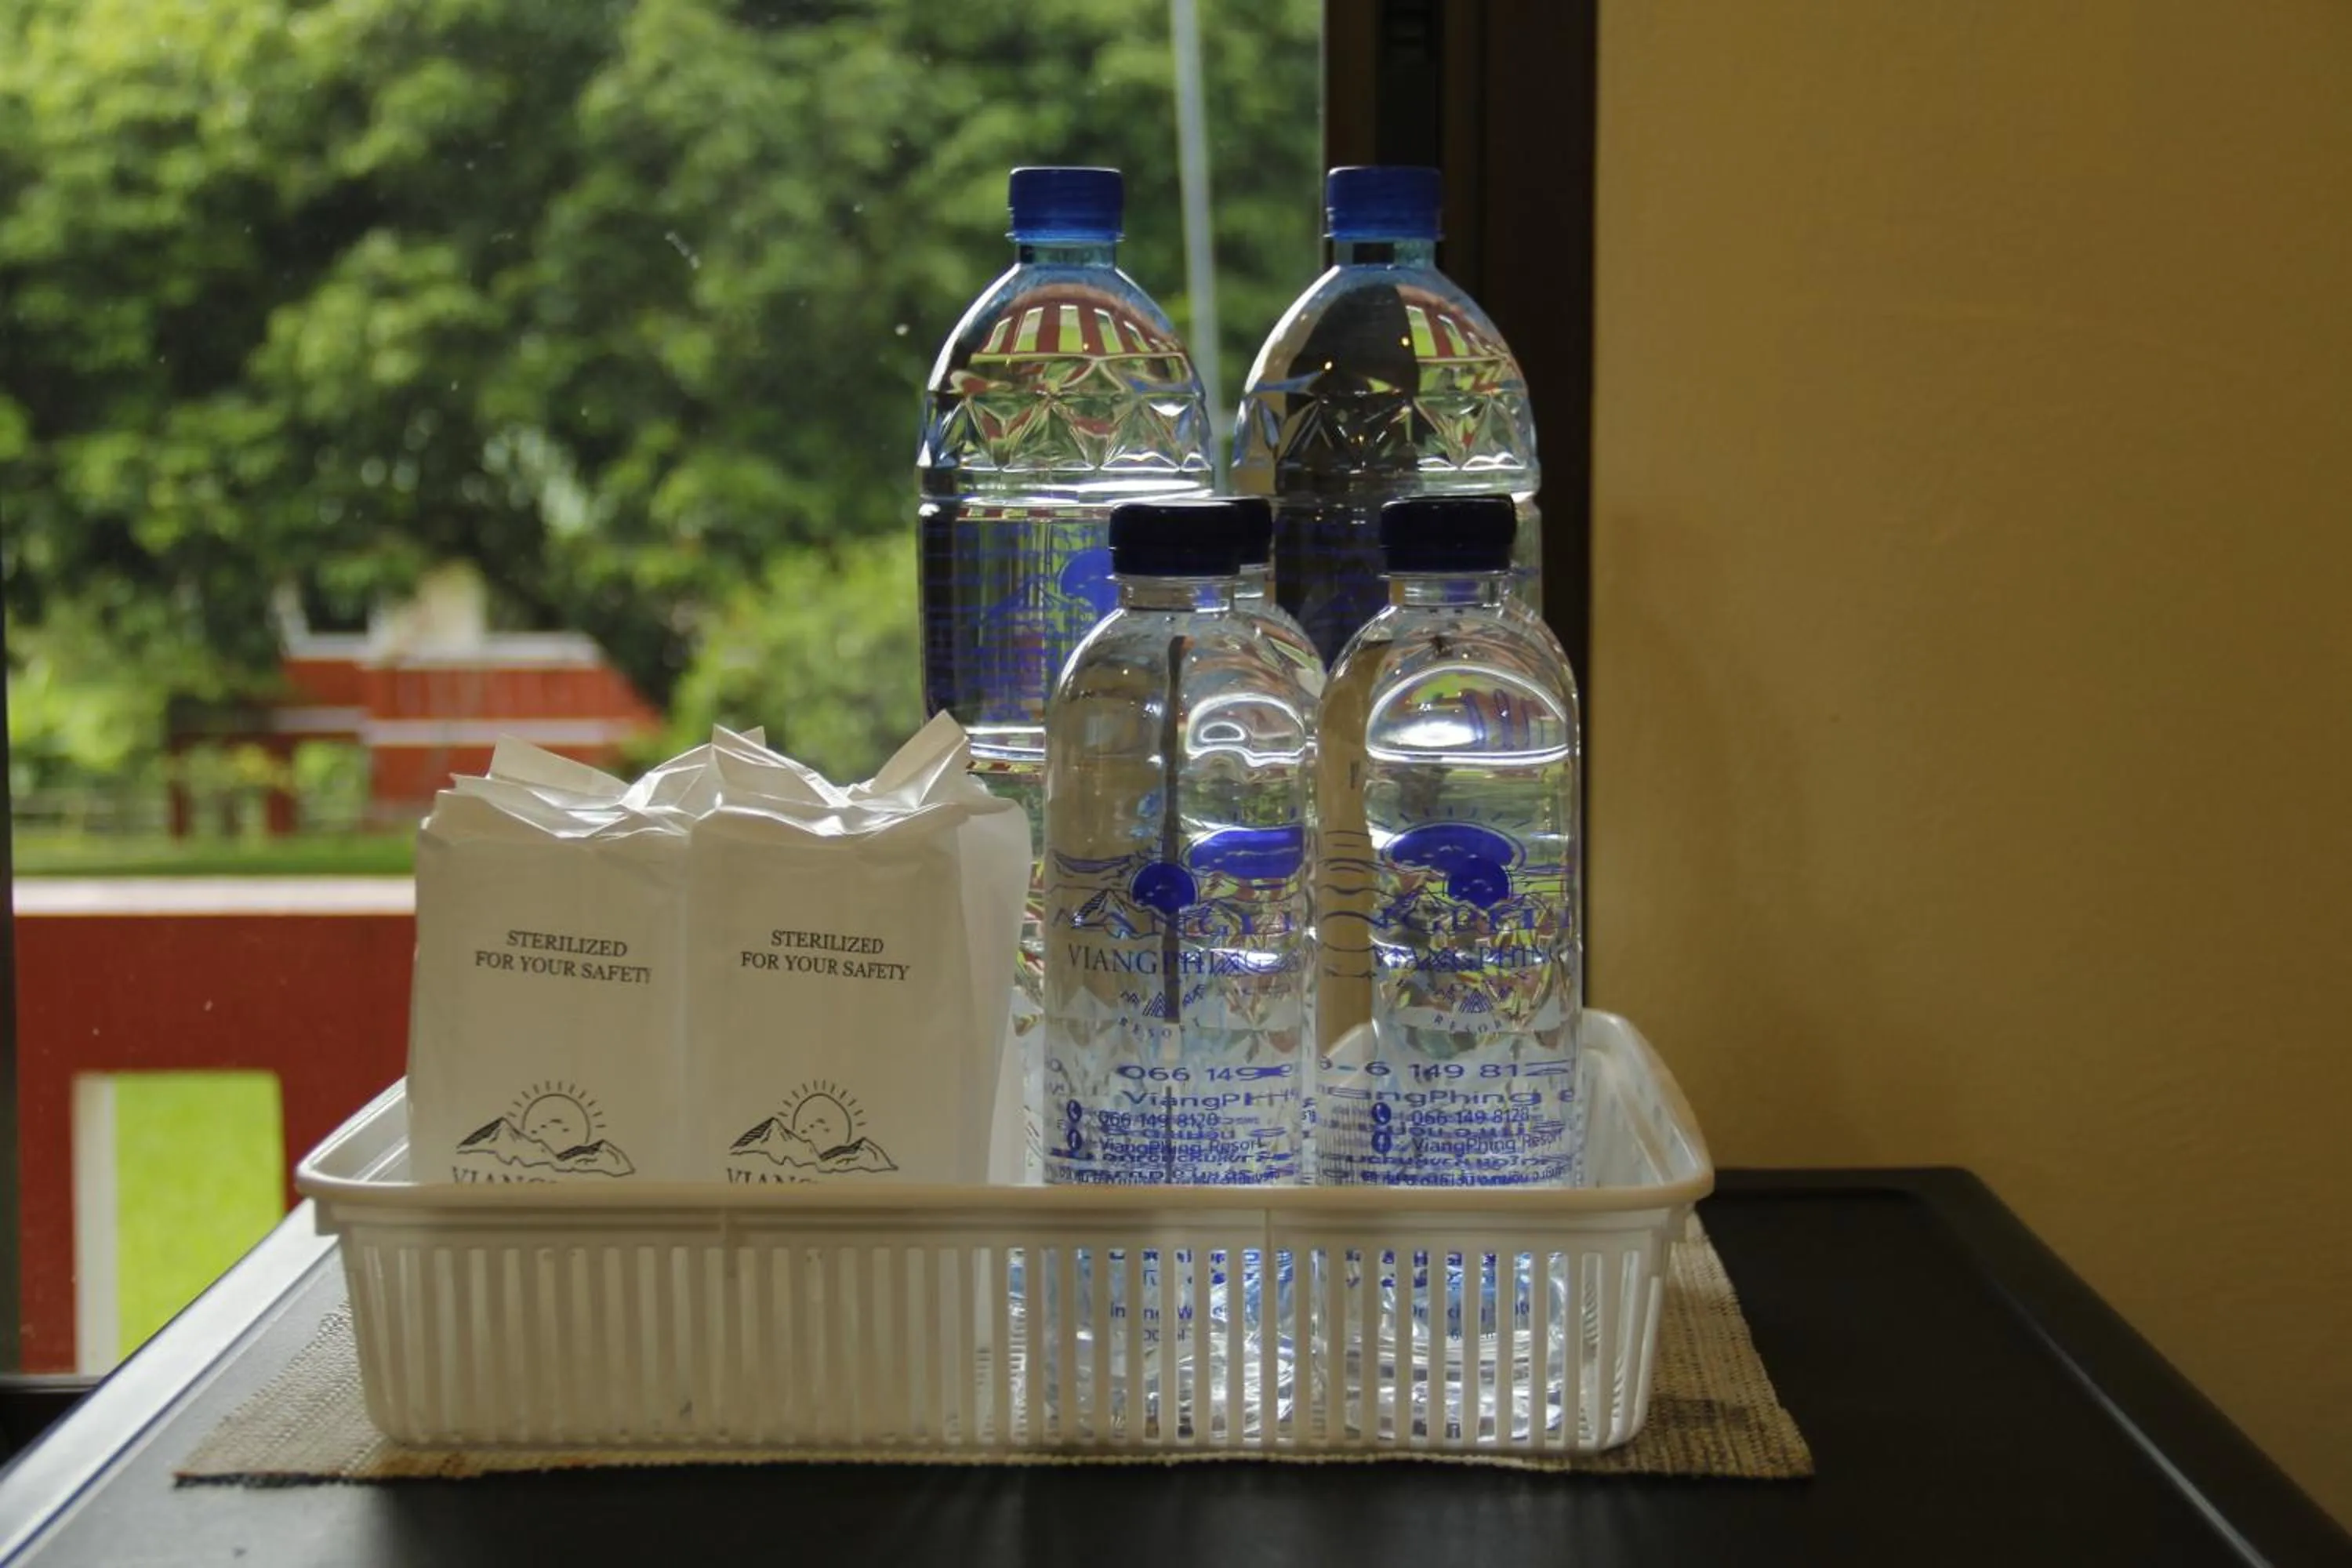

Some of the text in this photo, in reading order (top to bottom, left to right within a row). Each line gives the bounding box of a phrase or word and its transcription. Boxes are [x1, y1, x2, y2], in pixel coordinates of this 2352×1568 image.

[507, 930, 628, 957] STERILIZED
[771, 929, 884, 954] STERILIZED
[475, 950, 514, 970] FOR
[521, 956, 576, 977] YOUR
[740, 951, 911, 981] FOR YOUR SAFETY
